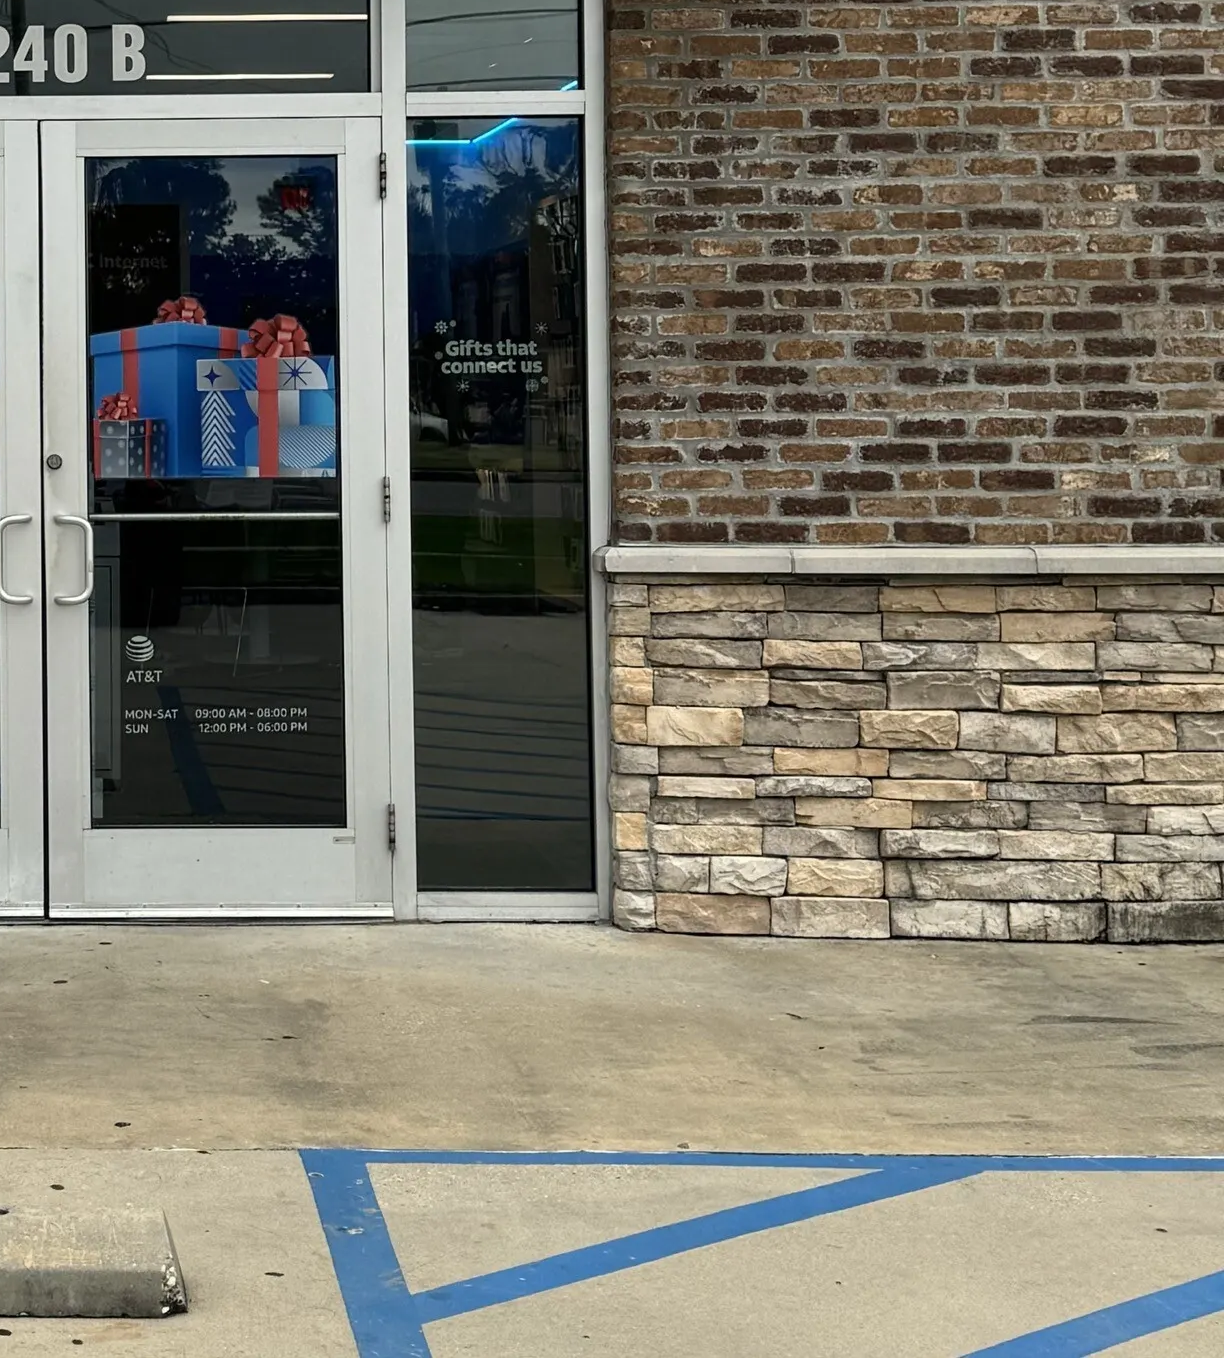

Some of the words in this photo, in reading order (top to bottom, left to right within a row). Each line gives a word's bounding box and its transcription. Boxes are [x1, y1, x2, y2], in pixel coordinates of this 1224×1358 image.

[112, 24, 147, 82] B
[99, 253, 168, 269] Internet
[445, 339, 493, 356] Gifts
[496, 338, 538, 356] that
[441, 358, 516, 374] connect
[520, 360, 543, 373] us
[126, 670, 163, 683] AT&T
[125, 709, 178, 719] MON-SAT
[195, 708, 226, 718] 09:00
[228, 708, 246, 718] AM
[257, 707, 287, 718] 08:00
[290, 707, 307, 717] PM
[125, 724, 149, 733] SUN
[198, 723, 227, 733] 12:00
[229, 723, 247, 732] PM
[257, 722, 288, 732] 06:00
[290, 722, 307, 731] PM
